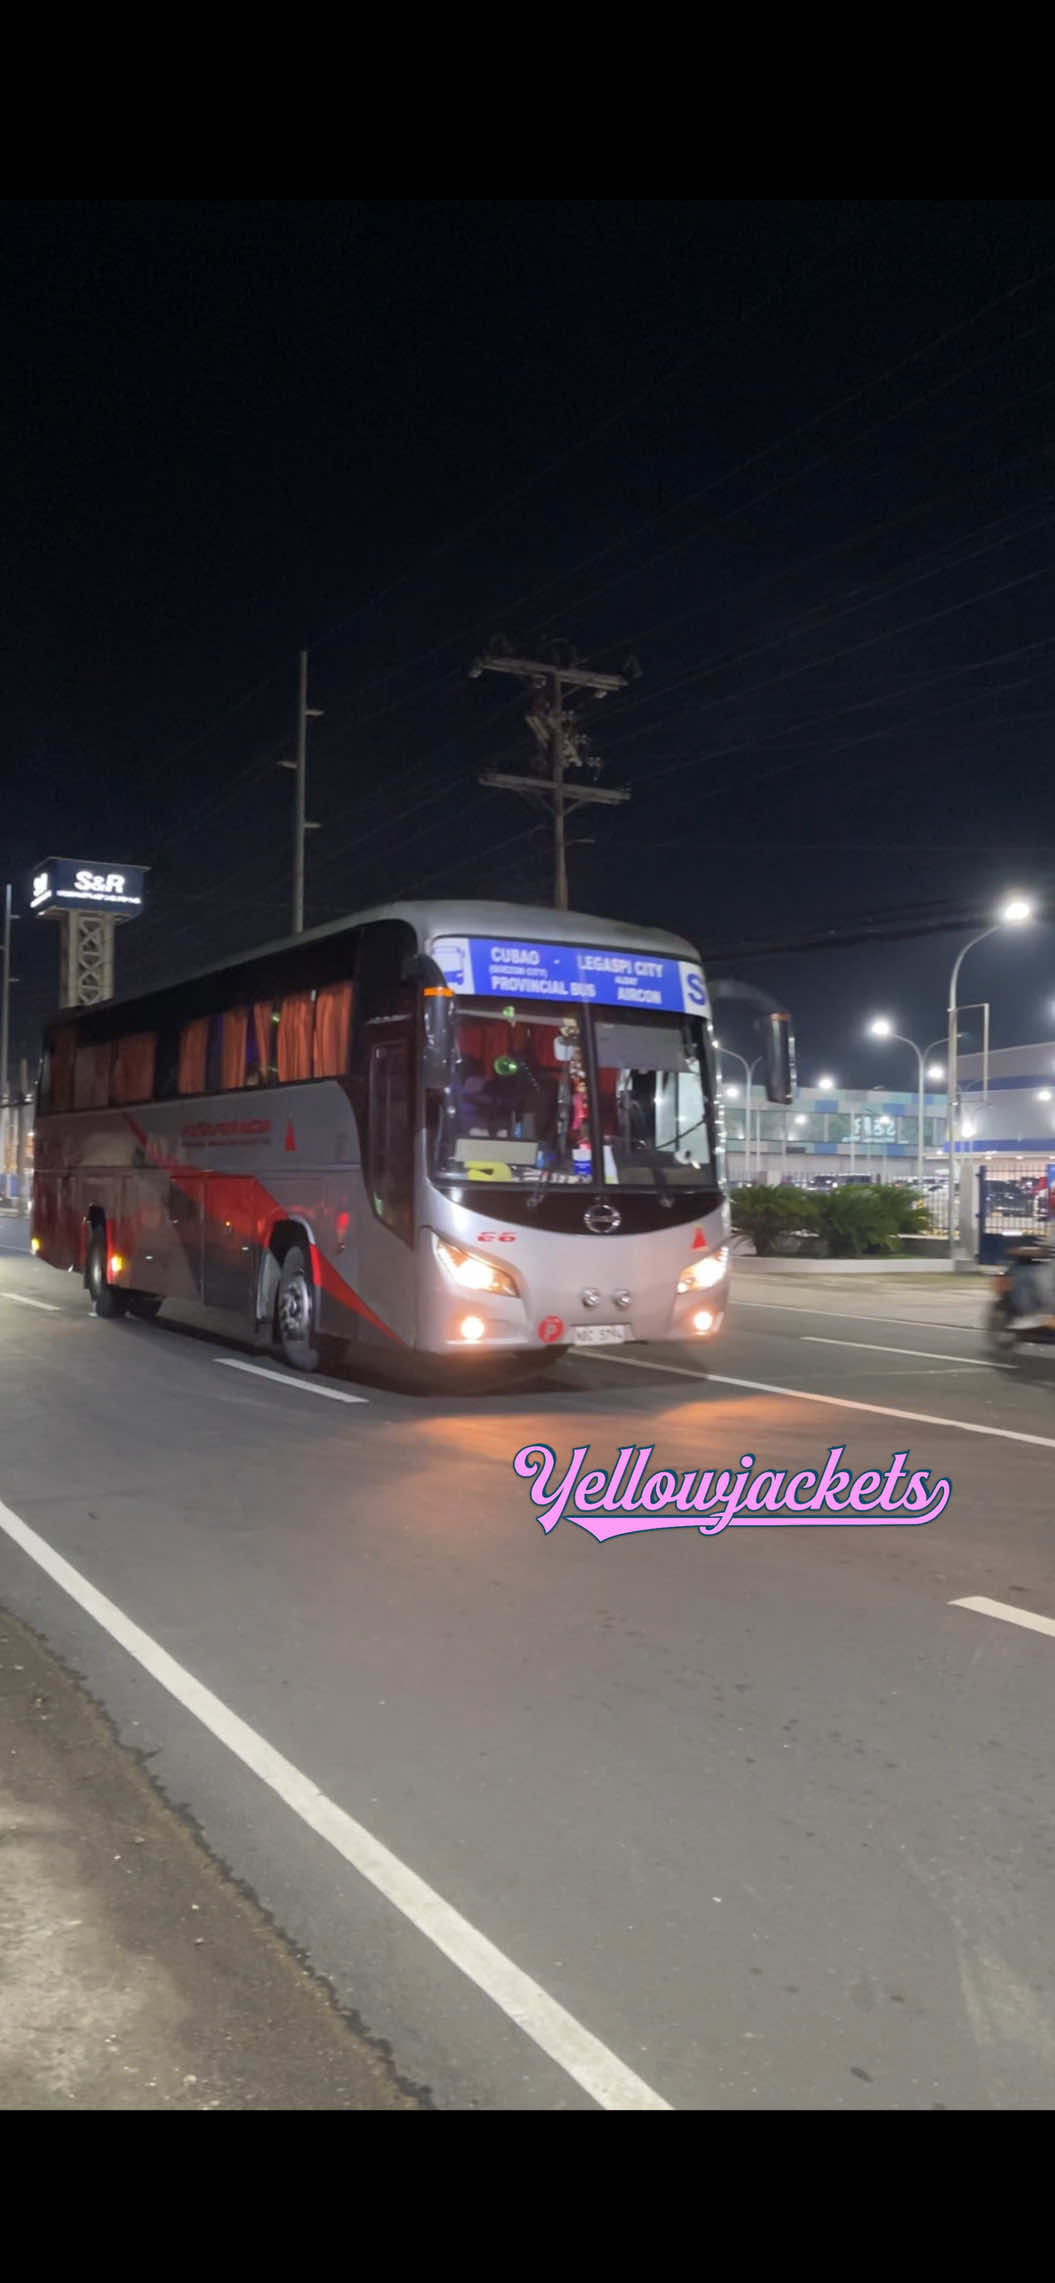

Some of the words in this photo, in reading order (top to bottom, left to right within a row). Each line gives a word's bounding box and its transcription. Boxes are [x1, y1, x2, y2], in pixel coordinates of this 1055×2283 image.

[74, 870, 125, 893] S&R
[491, 947, 540, 966] CUBAO
[577, 955, 632, 975] LEGASPI
[635, 962, 664, 978] CITY
[491, 975, 568, 997] PROVINCIAL
[570, 982, 596, 998] BUS
[617, 986, 663, 1005] AIRCON
